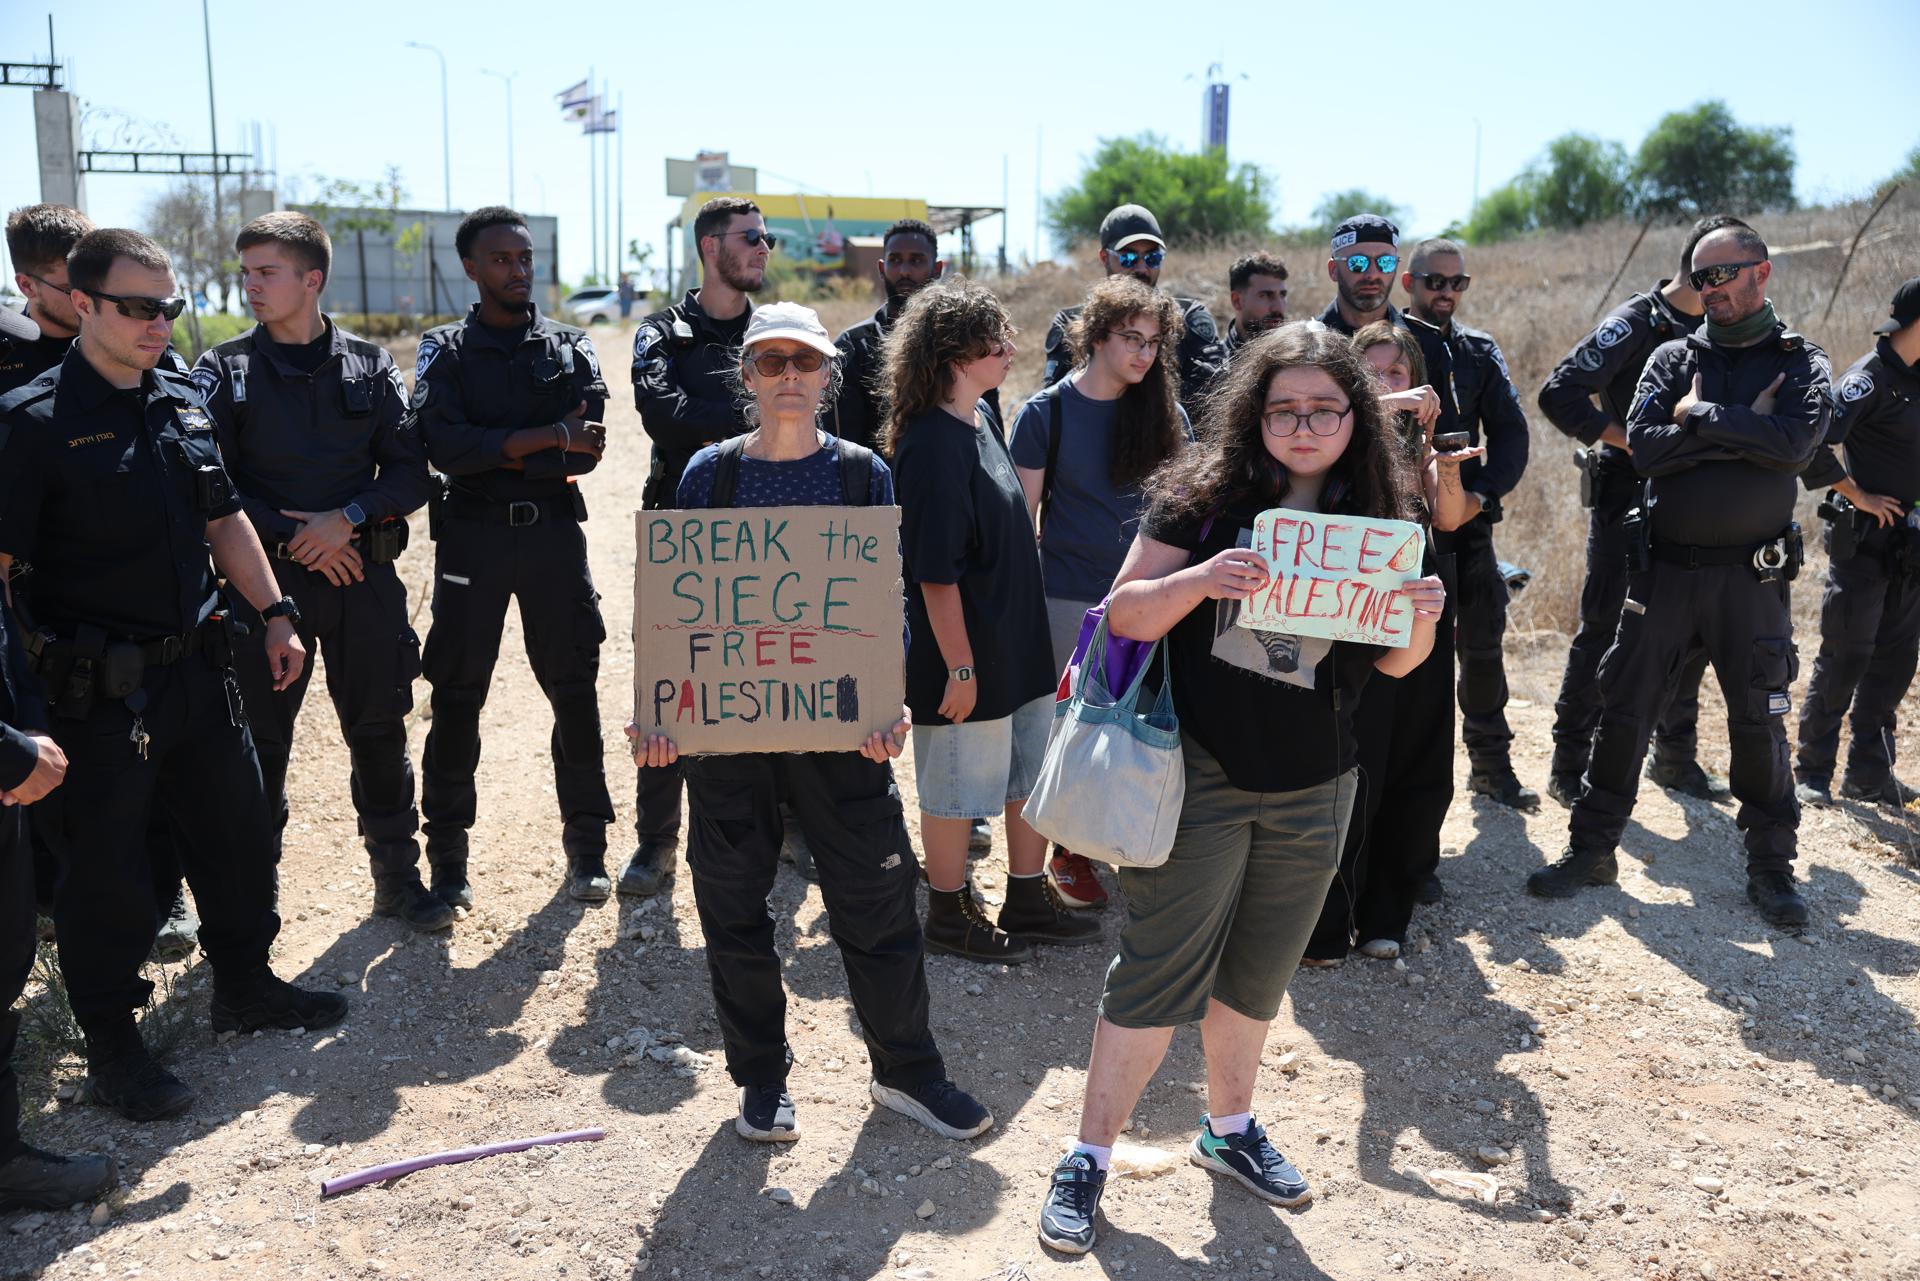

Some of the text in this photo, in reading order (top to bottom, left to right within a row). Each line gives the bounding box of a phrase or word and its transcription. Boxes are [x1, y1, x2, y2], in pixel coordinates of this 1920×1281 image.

[648, 518, 879, 564] BREAK the
[1272, 517, 1394, 574] FREE
[672, 570, 862, 631] SIEGE
[1249, 570, 1406, 635] PALESTINE
[690, 630, 819, 673] FREE
[654, 678, 835, 727] PALESTINE
